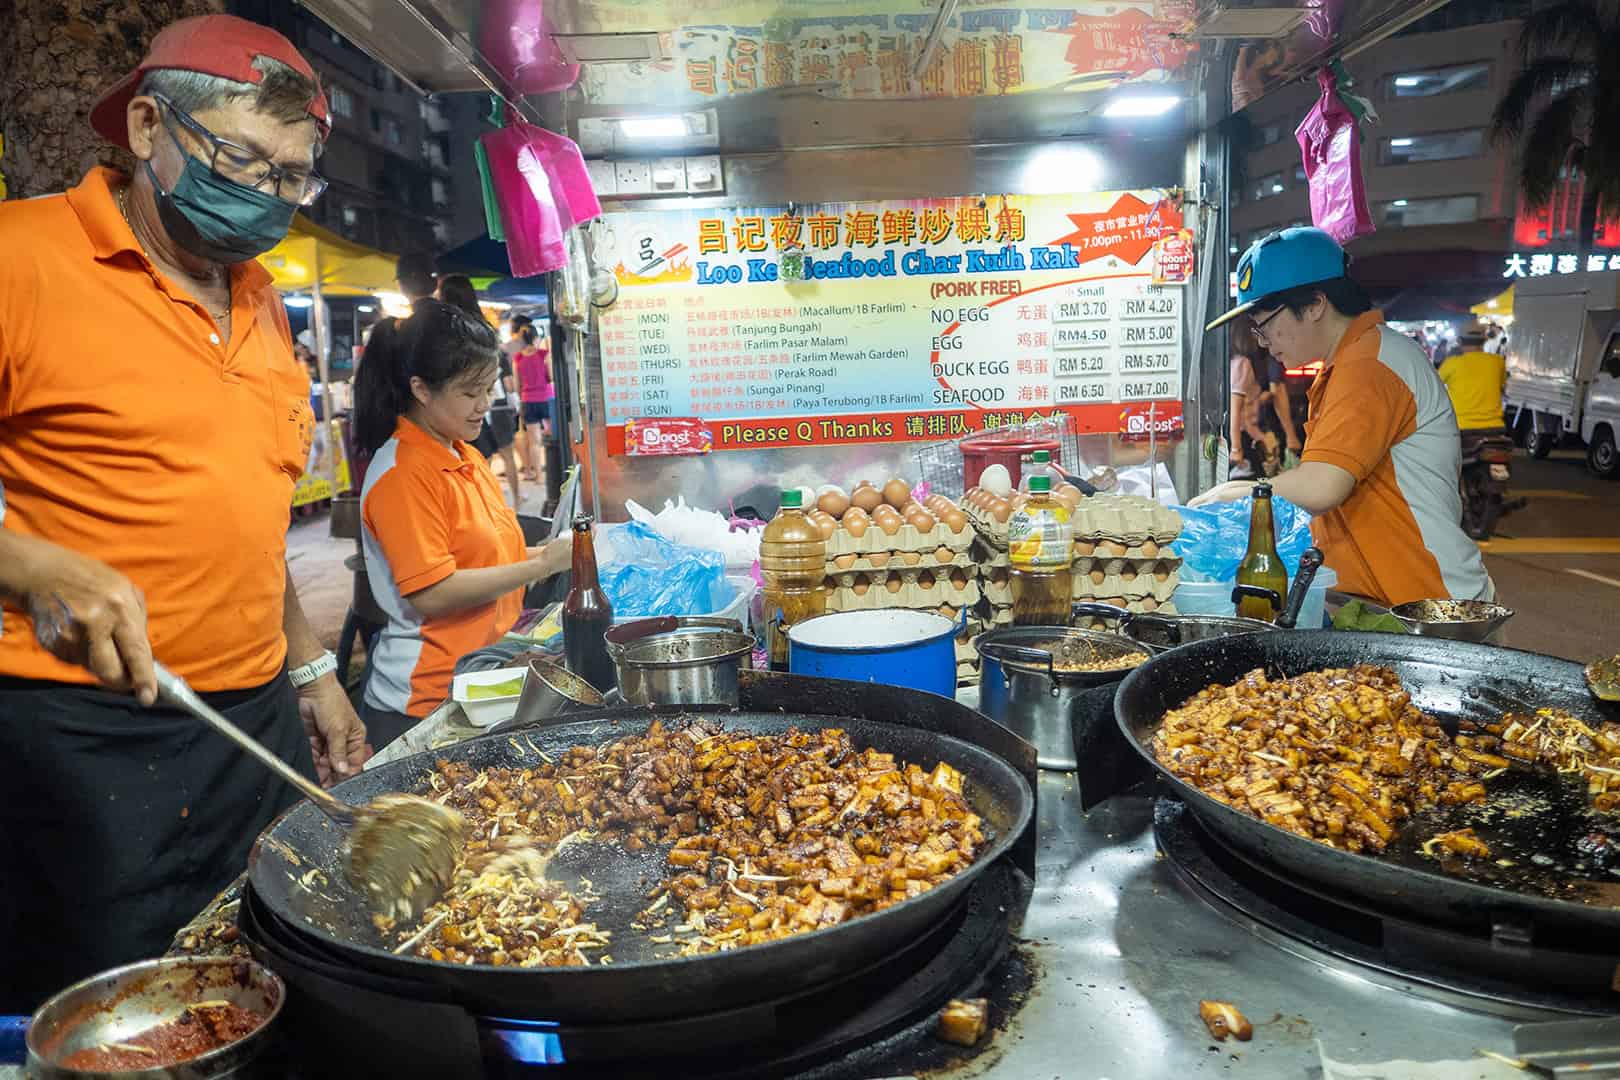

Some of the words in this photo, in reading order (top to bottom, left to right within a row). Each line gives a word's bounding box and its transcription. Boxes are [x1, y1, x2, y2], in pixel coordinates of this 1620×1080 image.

[639, 236, 655, 261] 吕
[1083, 233, 1122, 250] 7.00pm
[697, 262, 743, 285] Loo
[748, 259, 778, 283] Ke
[901, 249, 961, 276] Char
[966, 246, 1025, 273] Kuih
[1030, 243, 1080, 270] Kak
[931, 281, 978, 299] (PORK
[981, 279, 1022, 296] FREE)
[1077, 286, 1105, 297] Small
[799, 305, 870, 317] (Macallum/1B
[871, 302, 906, 313] Farlim)
[1016, 305, 1048, 321] 无蛋
[1060, 303, 1080, 318] RM
[1082, 301, 1107, 316] 3.70
[1126, 300, 1146, 314] RM
[1148, 298, 1173, 313] 4.20
[638, 314, 670, 325] (MON)
[931, 310, 954, 323] NO
[958, 306, 989, 321] EGG
[639, 329, 665, 341] (TUE)
[732, 324, 776, 337] (Tanjung
[779, 322, 822, 335] Bungah)
[1126, 327, 1146, 341] RM
[1148, 325, 1173, 339] 5.00
[744, 339, 779, 350] (Farlim
[781, 338, 808, 348] Pasar
[810, 336, 848, 348] Malam)
[931, 336, 963, 350] EGG
[1016, 332, 1049, 347] 鸡蛋
[640, 344, 670, 355] (WED)
[793, 352, 828, 363] (Farlim
[830, 352, 867, 361] Mewah
[869, 349, 908, 360] Garden)
[641, 359, 681, 371] (THURS)
[1059, 358, 1078, 372] RM
[1125, 355, 1143, 368] RM
[1145, 353, 1169, 368] 5.70
[774, 368, 806, 380] (Perak
[808, 367, 838, 378] Road)
[931, 361, 975, 377] DUCK
[979, 360, 1009, 375] EGG
[641, 375, 664, 386] (FRI)
[642, 390, 669, 402] (SAT)
[747, 385, 785, 397] (Sungai
[787, 383, 825, 396] Pinang)
[932, 387, 1005, 404] SEAFOOD
[1017, 384, 1049, 401] 海鲜
[1060, 385, 1079, 399] RM
[1081, 384, 1104, 398] 6.50
[1125, 383, 1144, 397] RM
[1145, 382, 1169, 397] 7.00
[793, 398, 821, 409] (Paya
[823, 395, 887, 408] Terubong/1B
[889, 393, 924, 405] Farlim)
[643, 405, 672, 416] (SUN)
[722, 424, 789, 444] Please
[796, 422, 814, 443] Q
[820, 419, 893, 440] Thanks
